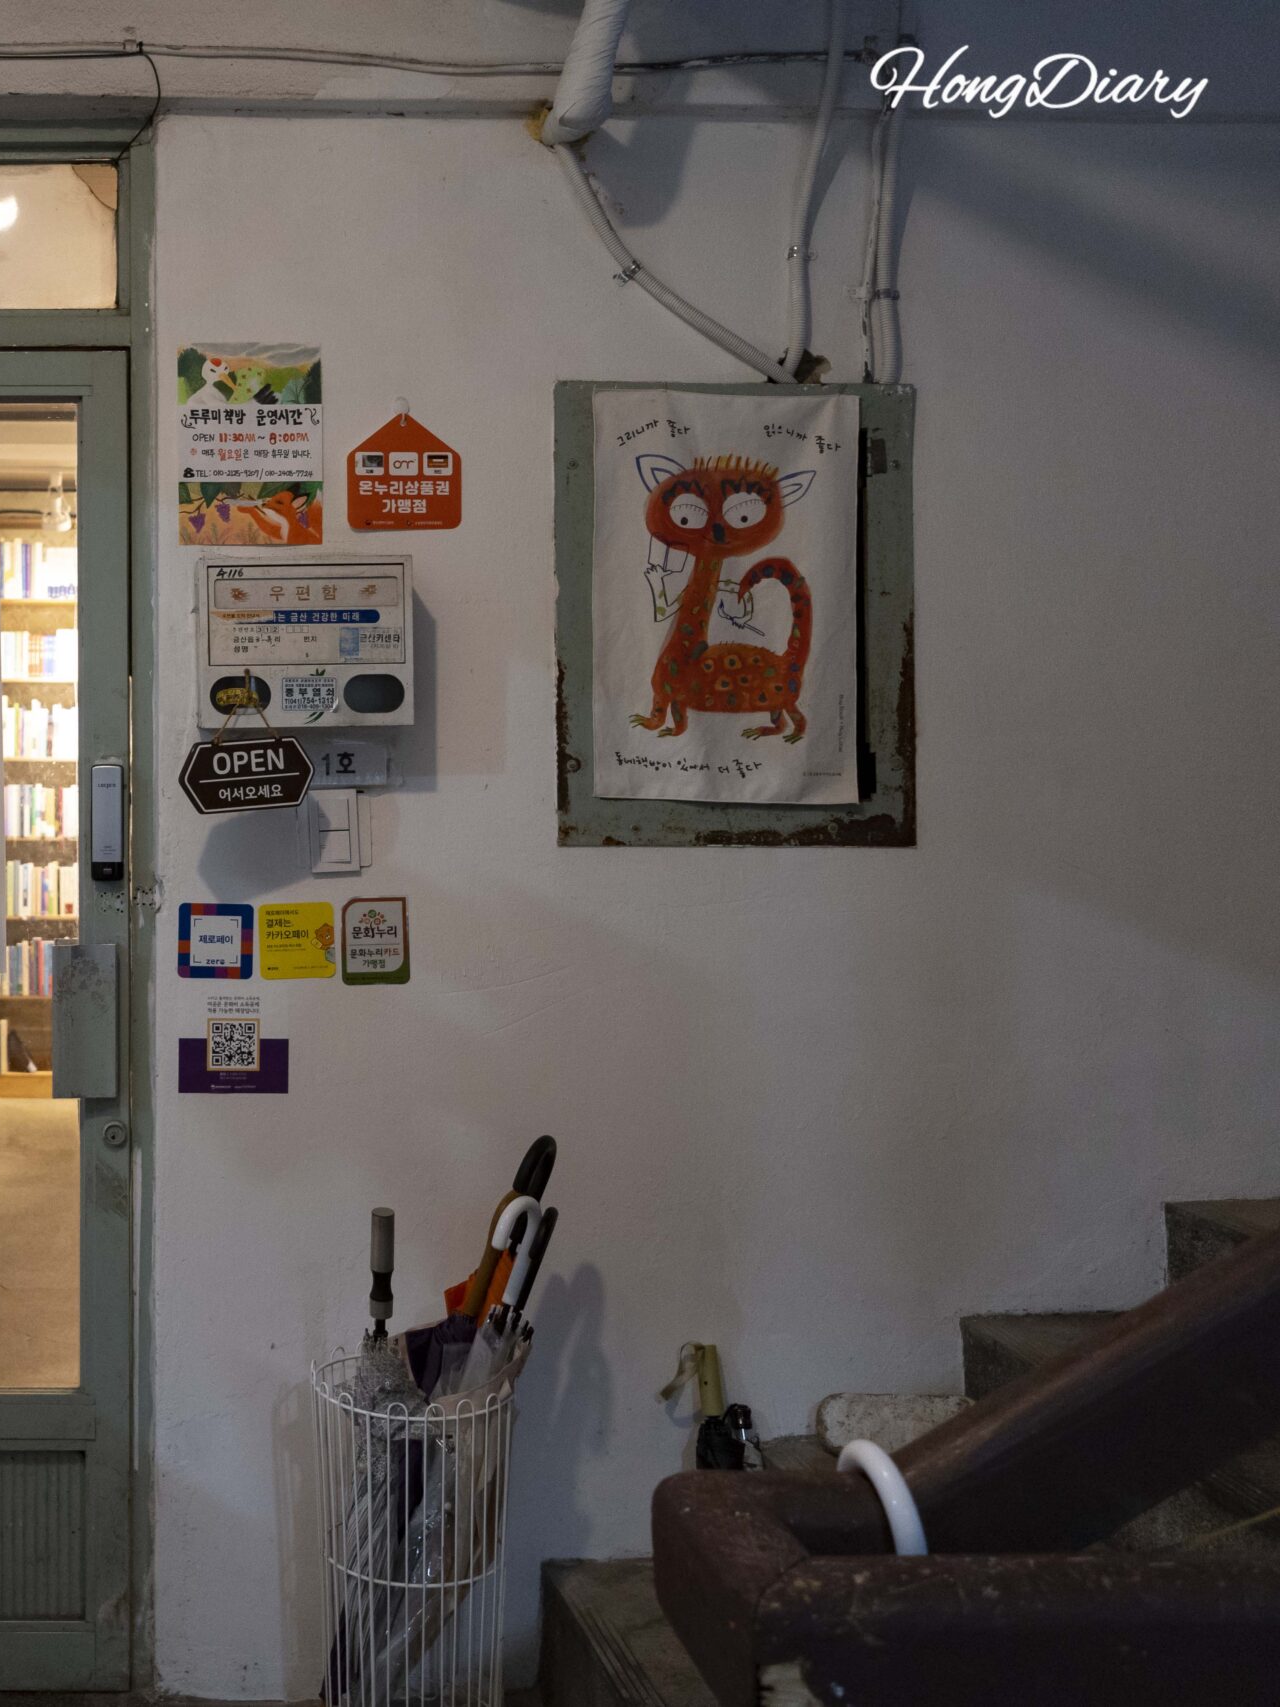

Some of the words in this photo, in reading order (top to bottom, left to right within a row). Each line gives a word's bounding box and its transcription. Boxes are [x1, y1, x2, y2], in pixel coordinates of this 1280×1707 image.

[190, 409, 221, 424] 두루미
[224, 409, 246, 424] 책방
[256, 409, 302, 426] 운영시간
[192, 434, 214, 442] OPEN
[219, 432, 256, 442] 11:30AM
[269, 432, 310, 445] 8:00PM
[617, 420, 660, 447] 그리니까
[666, 419, 690, 438] 좋다
[764, 423, 808, 441] 읽으니까
[815, 436, 842, 454] 좋다
[202, 449, 216, 458] 매주
[218, 448, 249, 461] 월요일은
[271, 449, 290, 458] 휴무일
[359, 480, 450, 495] 온누리상품권
[382, 499, 426, 514] 가맹점
[290, 612, 308, 622] 금산
[312, 612, 338, 622] 건강한
[342, 612, 360, 622] 미래
[212, 748, 284, 774] OPEN
[615, 751, 672, 771] 동네책방이
[718, 766, 730, 774] 더
[732, 759, 762, 778] 좋다
[218, 784, 283, 802] 어서오세요
[266, 930, 309, 940] 카카오페이
[352, 922, 397, 939] 문화누리
[198, 934, 233, 944] 제로페이
[350, 948, 400, 959] 문화누리카드
[362, 959, 386, 969] 가맹점
